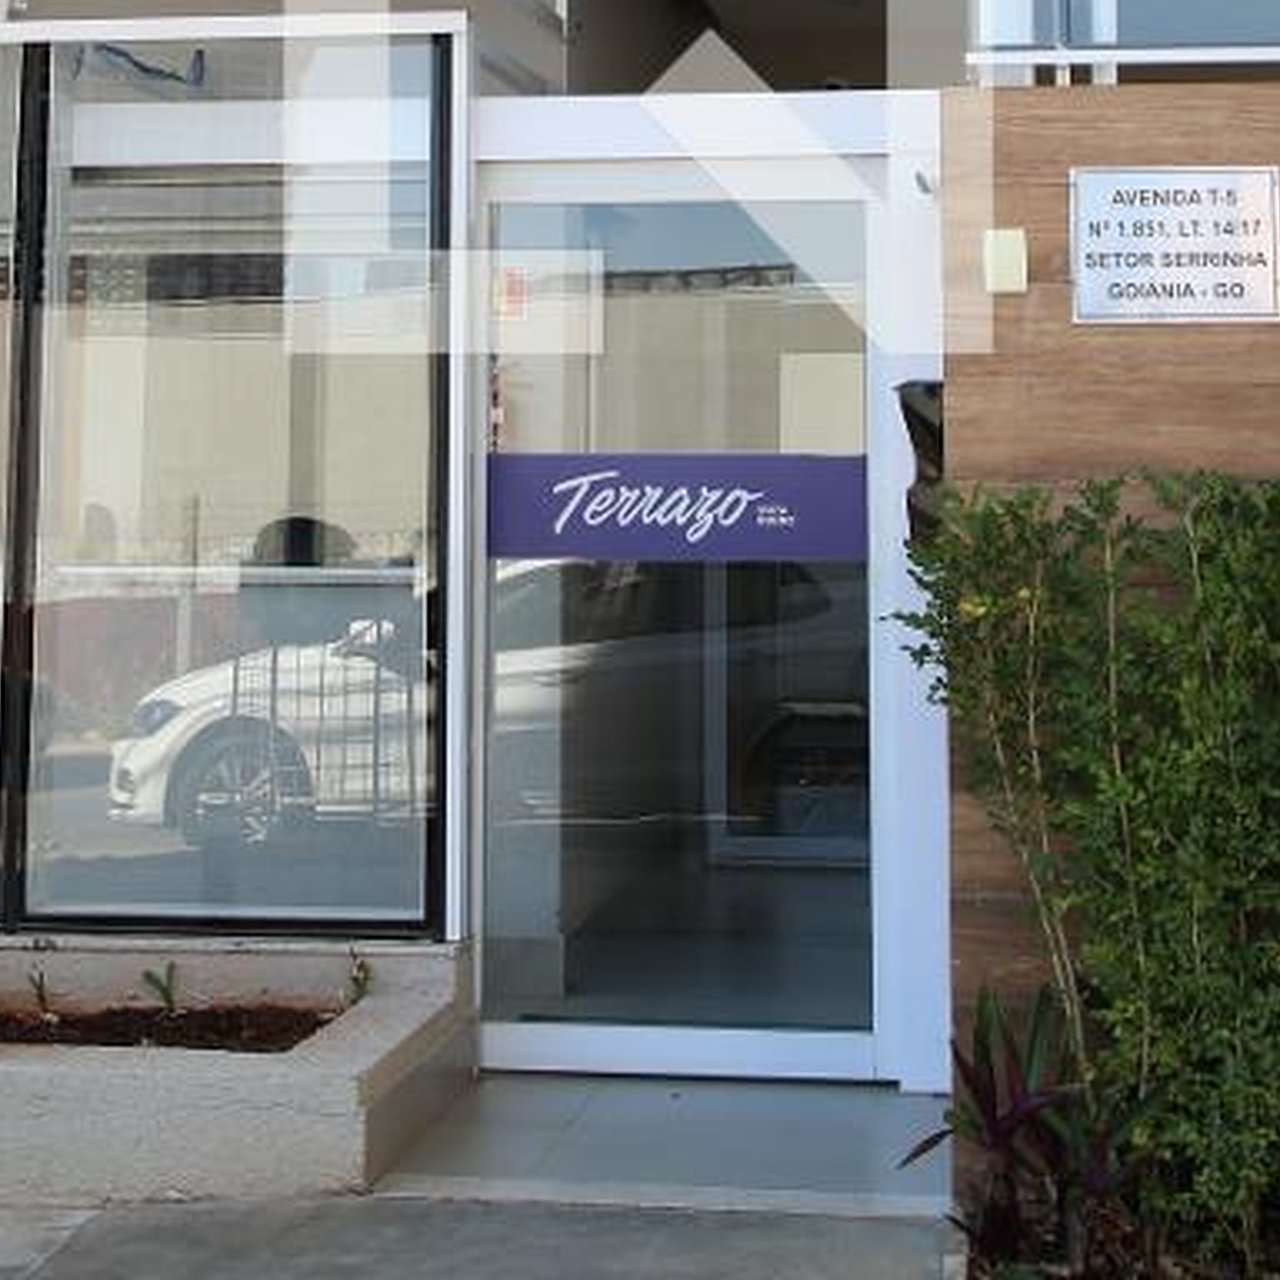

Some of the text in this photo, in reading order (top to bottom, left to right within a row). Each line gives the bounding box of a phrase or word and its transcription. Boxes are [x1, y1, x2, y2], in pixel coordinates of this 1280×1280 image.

[1112, 189, 1203, 206] AVENIDA
[1085, 252, 1154, 268] SETOR
[1213, 282, 1245, 298] GO
[553, 470, 763, 544] Terrazo
